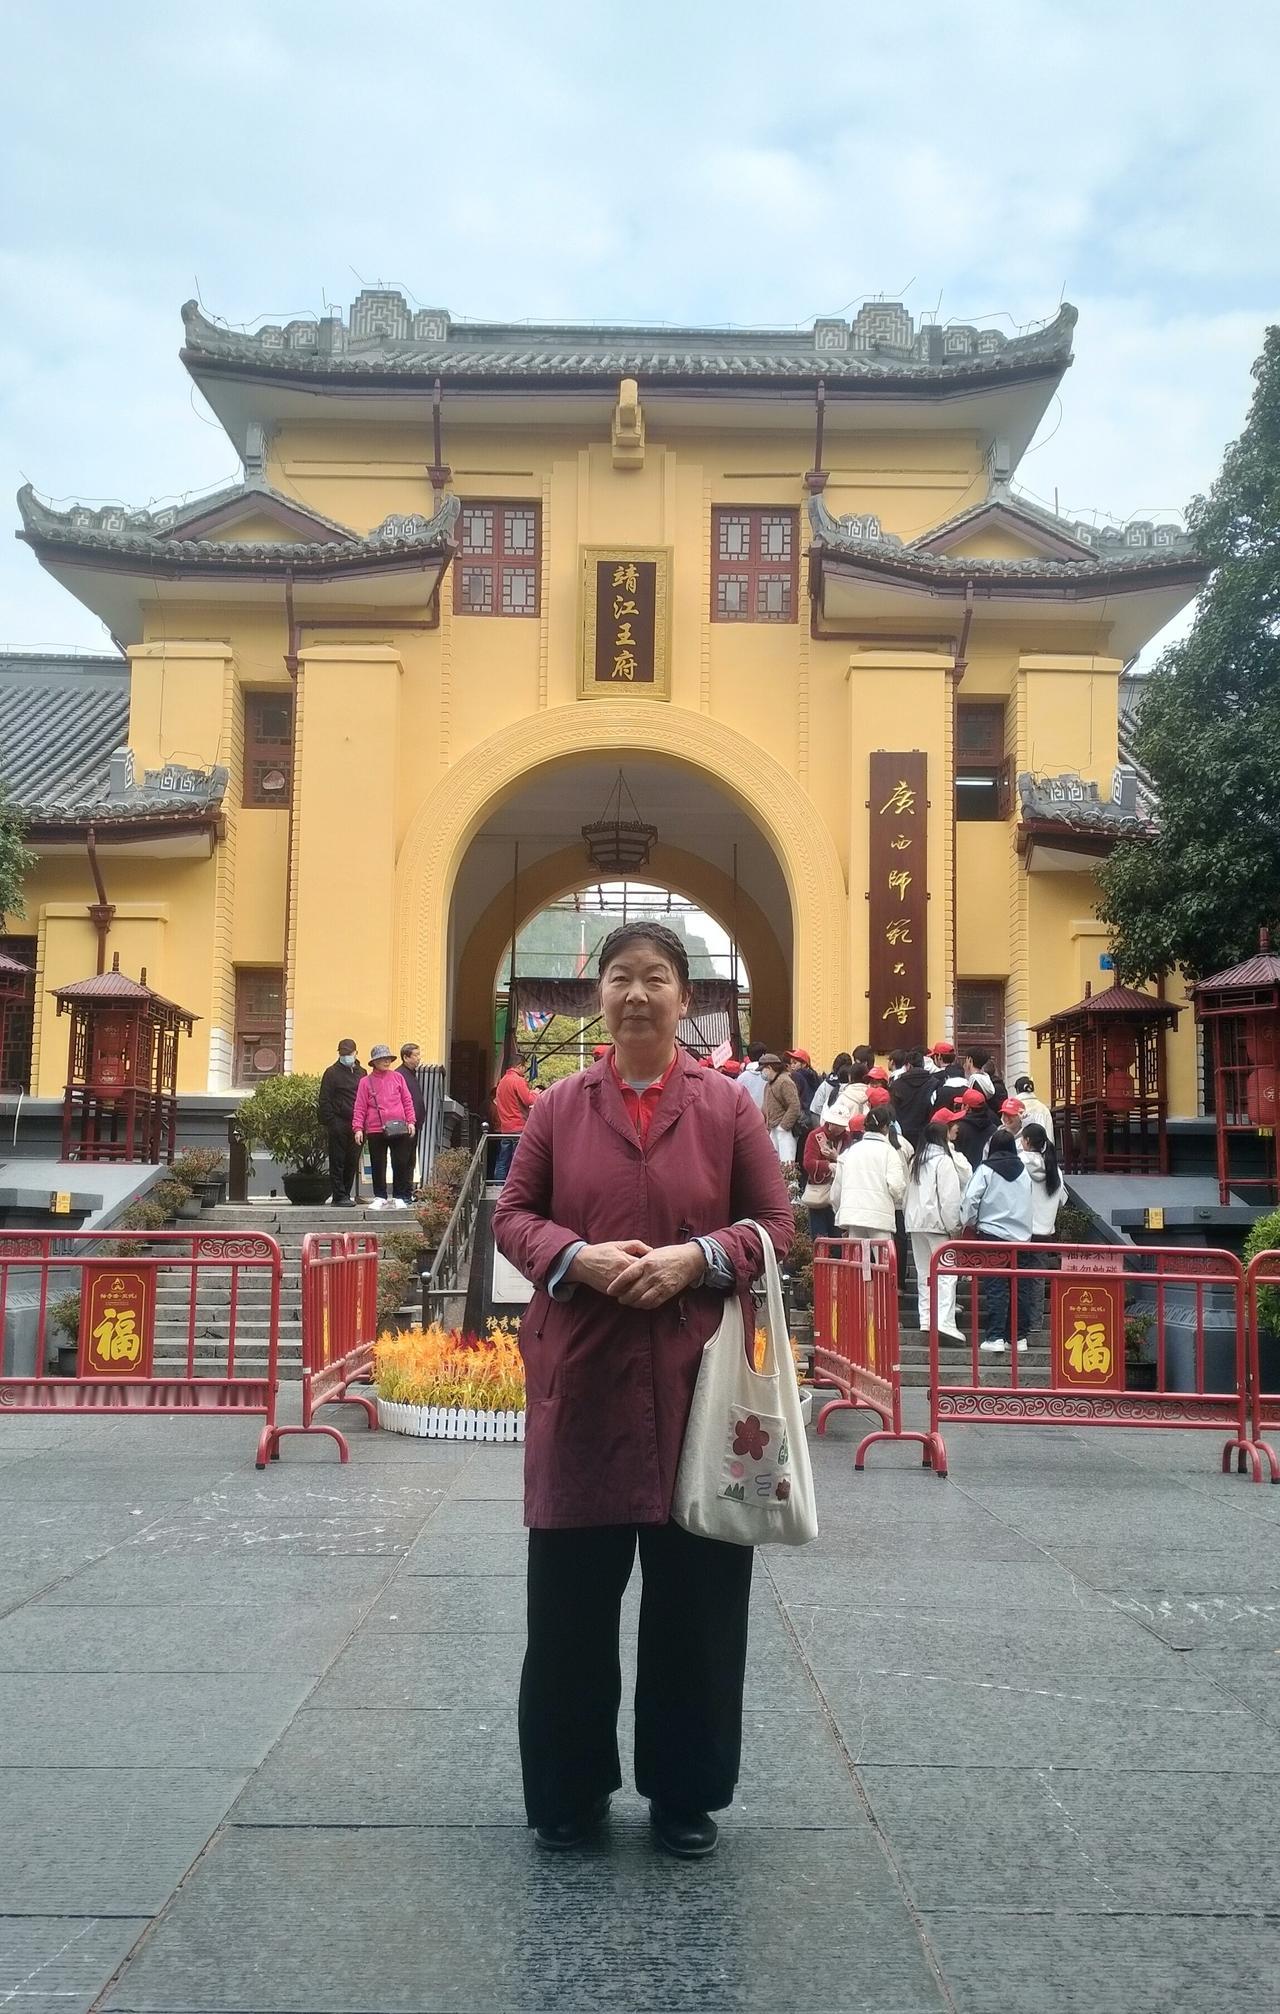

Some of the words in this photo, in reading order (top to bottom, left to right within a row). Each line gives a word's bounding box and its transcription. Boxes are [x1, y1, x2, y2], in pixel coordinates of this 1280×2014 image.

[612, 564, 640, 681] 靖江王府
[93, 1308, 139, 1361] 福
[1064, 1321, 1111, 1374] 福
